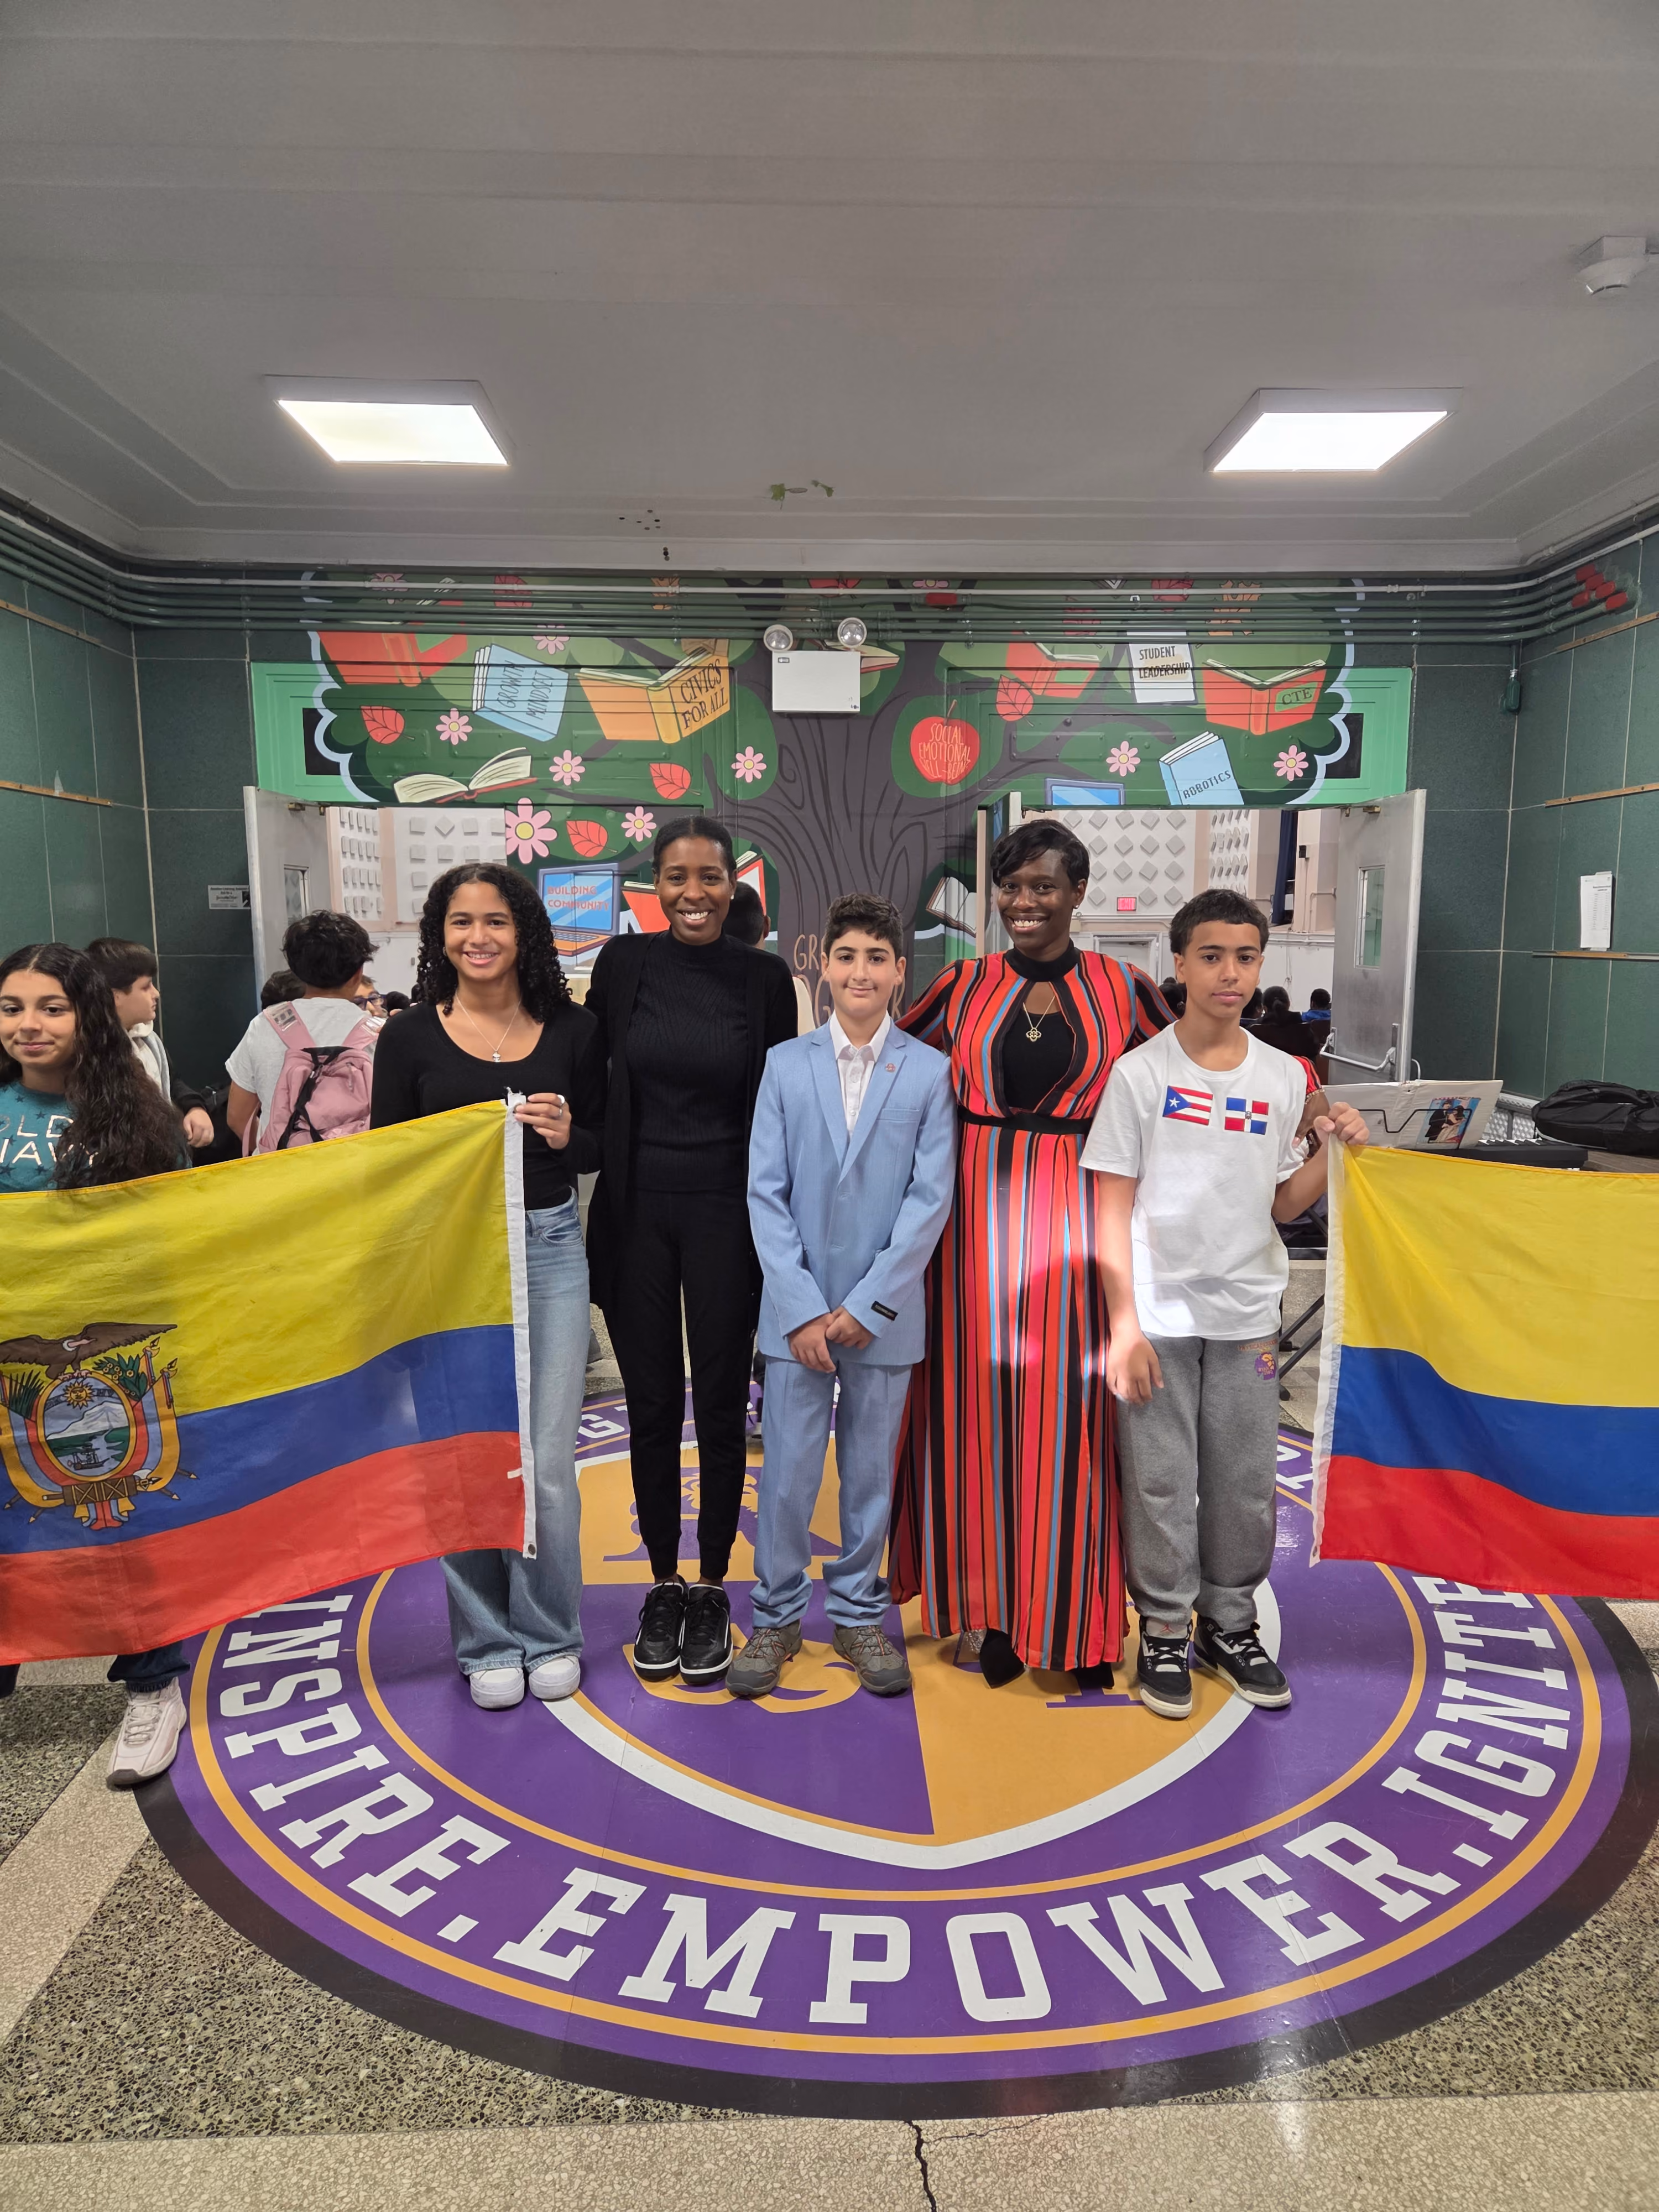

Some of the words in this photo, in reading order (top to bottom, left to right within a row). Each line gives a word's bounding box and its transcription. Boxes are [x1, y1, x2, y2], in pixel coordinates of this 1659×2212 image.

[1139, 646, 1175, 660] STUDENT
[681, 659, 722, 703] CIVICS
[1139, 662, 1190, 679] LEADERSHIP
[497, 660, 524, 708] GROWTH
[526, 670, 554, 720] MINDSET
[1282, 688, 1312, 705] CTE
[681, 701, 709, 729] FOR
[711, 687, 728, 714] ALL
[929, 723, 964, 745] SOCIAL
[919, 742, 971, 762] EMOTIONAL
[1182, 770, 1232, 799] ROBOTICS
[547, 886, 596, 895] BUILDING
[547, 899, 609, 910] COMMUNITY
[1381, 1576, 1571, 1840] IGNITE
